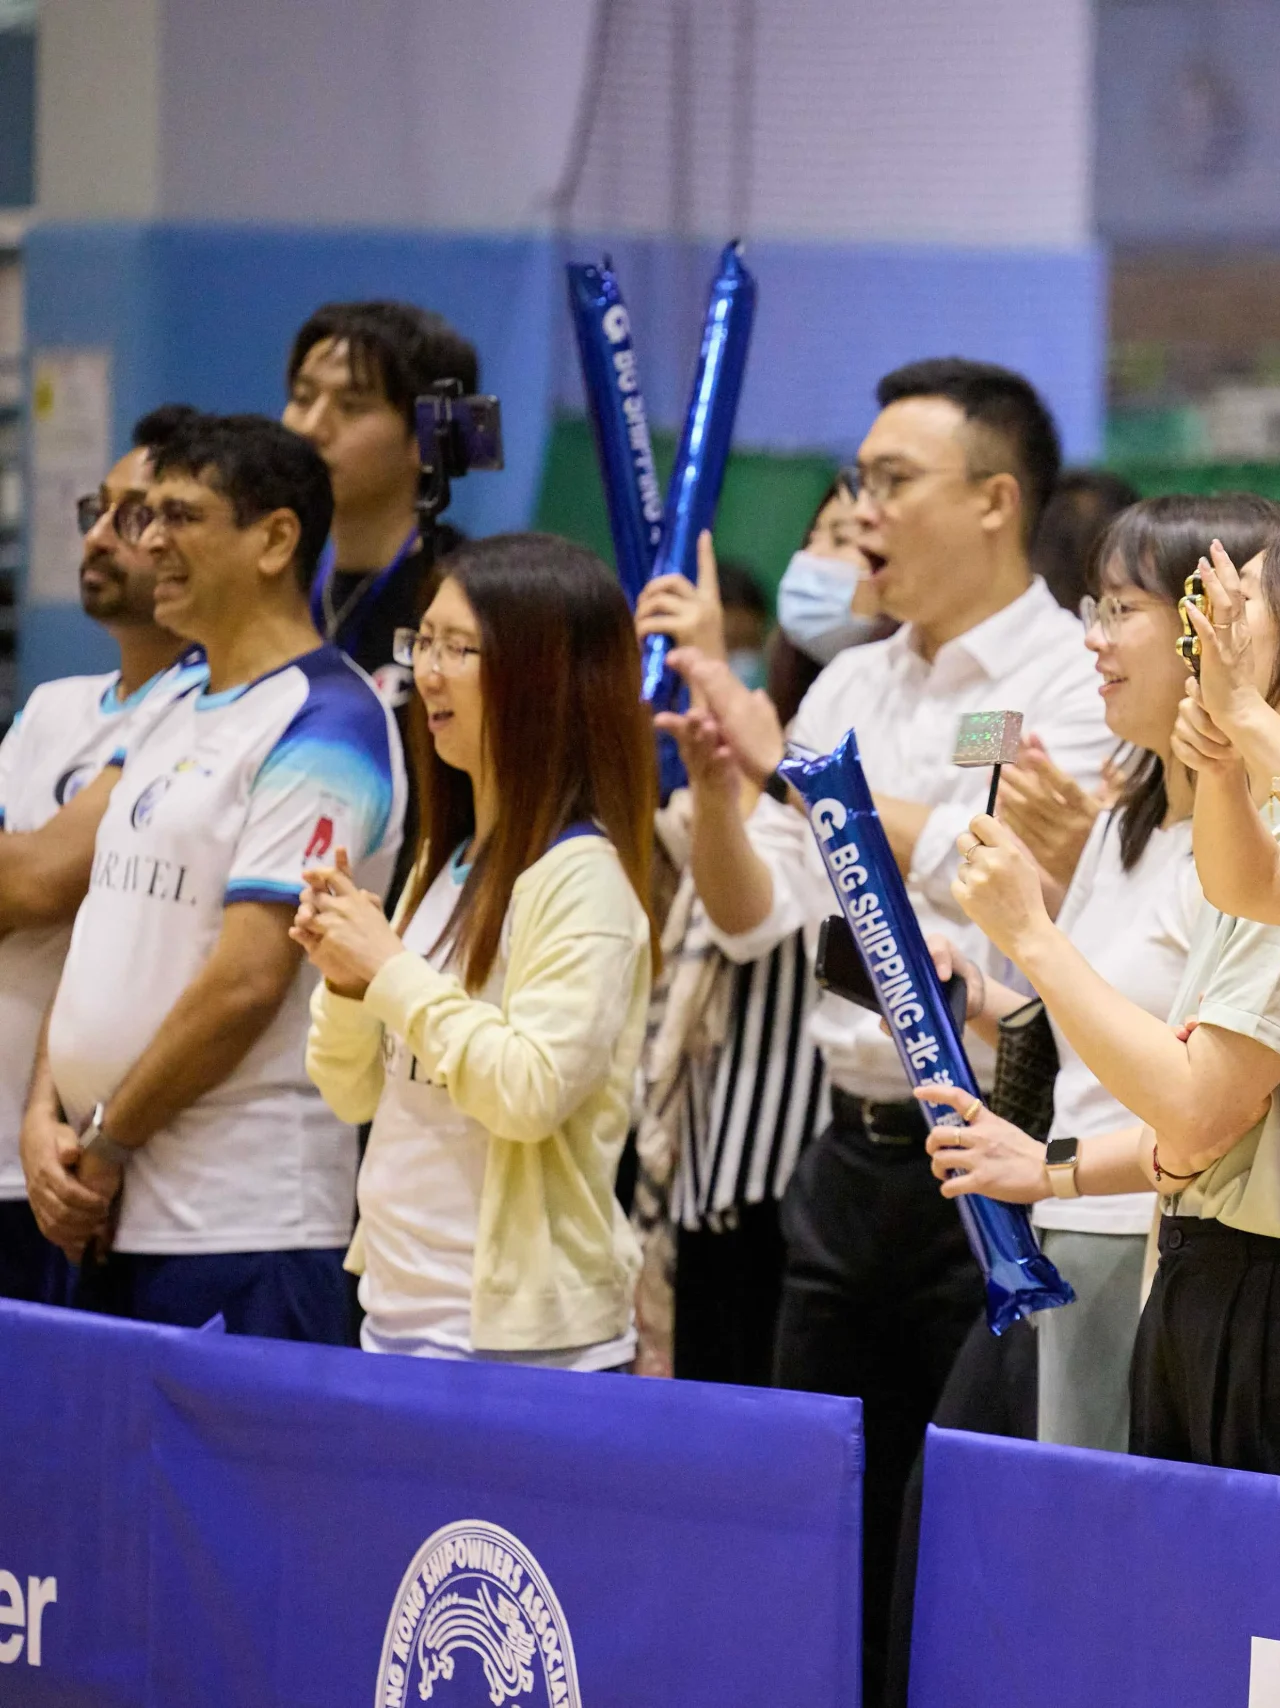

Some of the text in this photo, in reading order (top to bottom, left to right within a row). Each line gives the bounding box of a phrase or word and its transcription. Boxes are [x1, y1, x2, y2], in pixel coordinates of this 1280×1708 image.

[828, 842, 868, 893] BG
[849, 892, 925, 1031] SHIPPING
[392, 1580, 425, 1663] KONG
[421, 1537, 524, 1595] SHIPOWNERS
